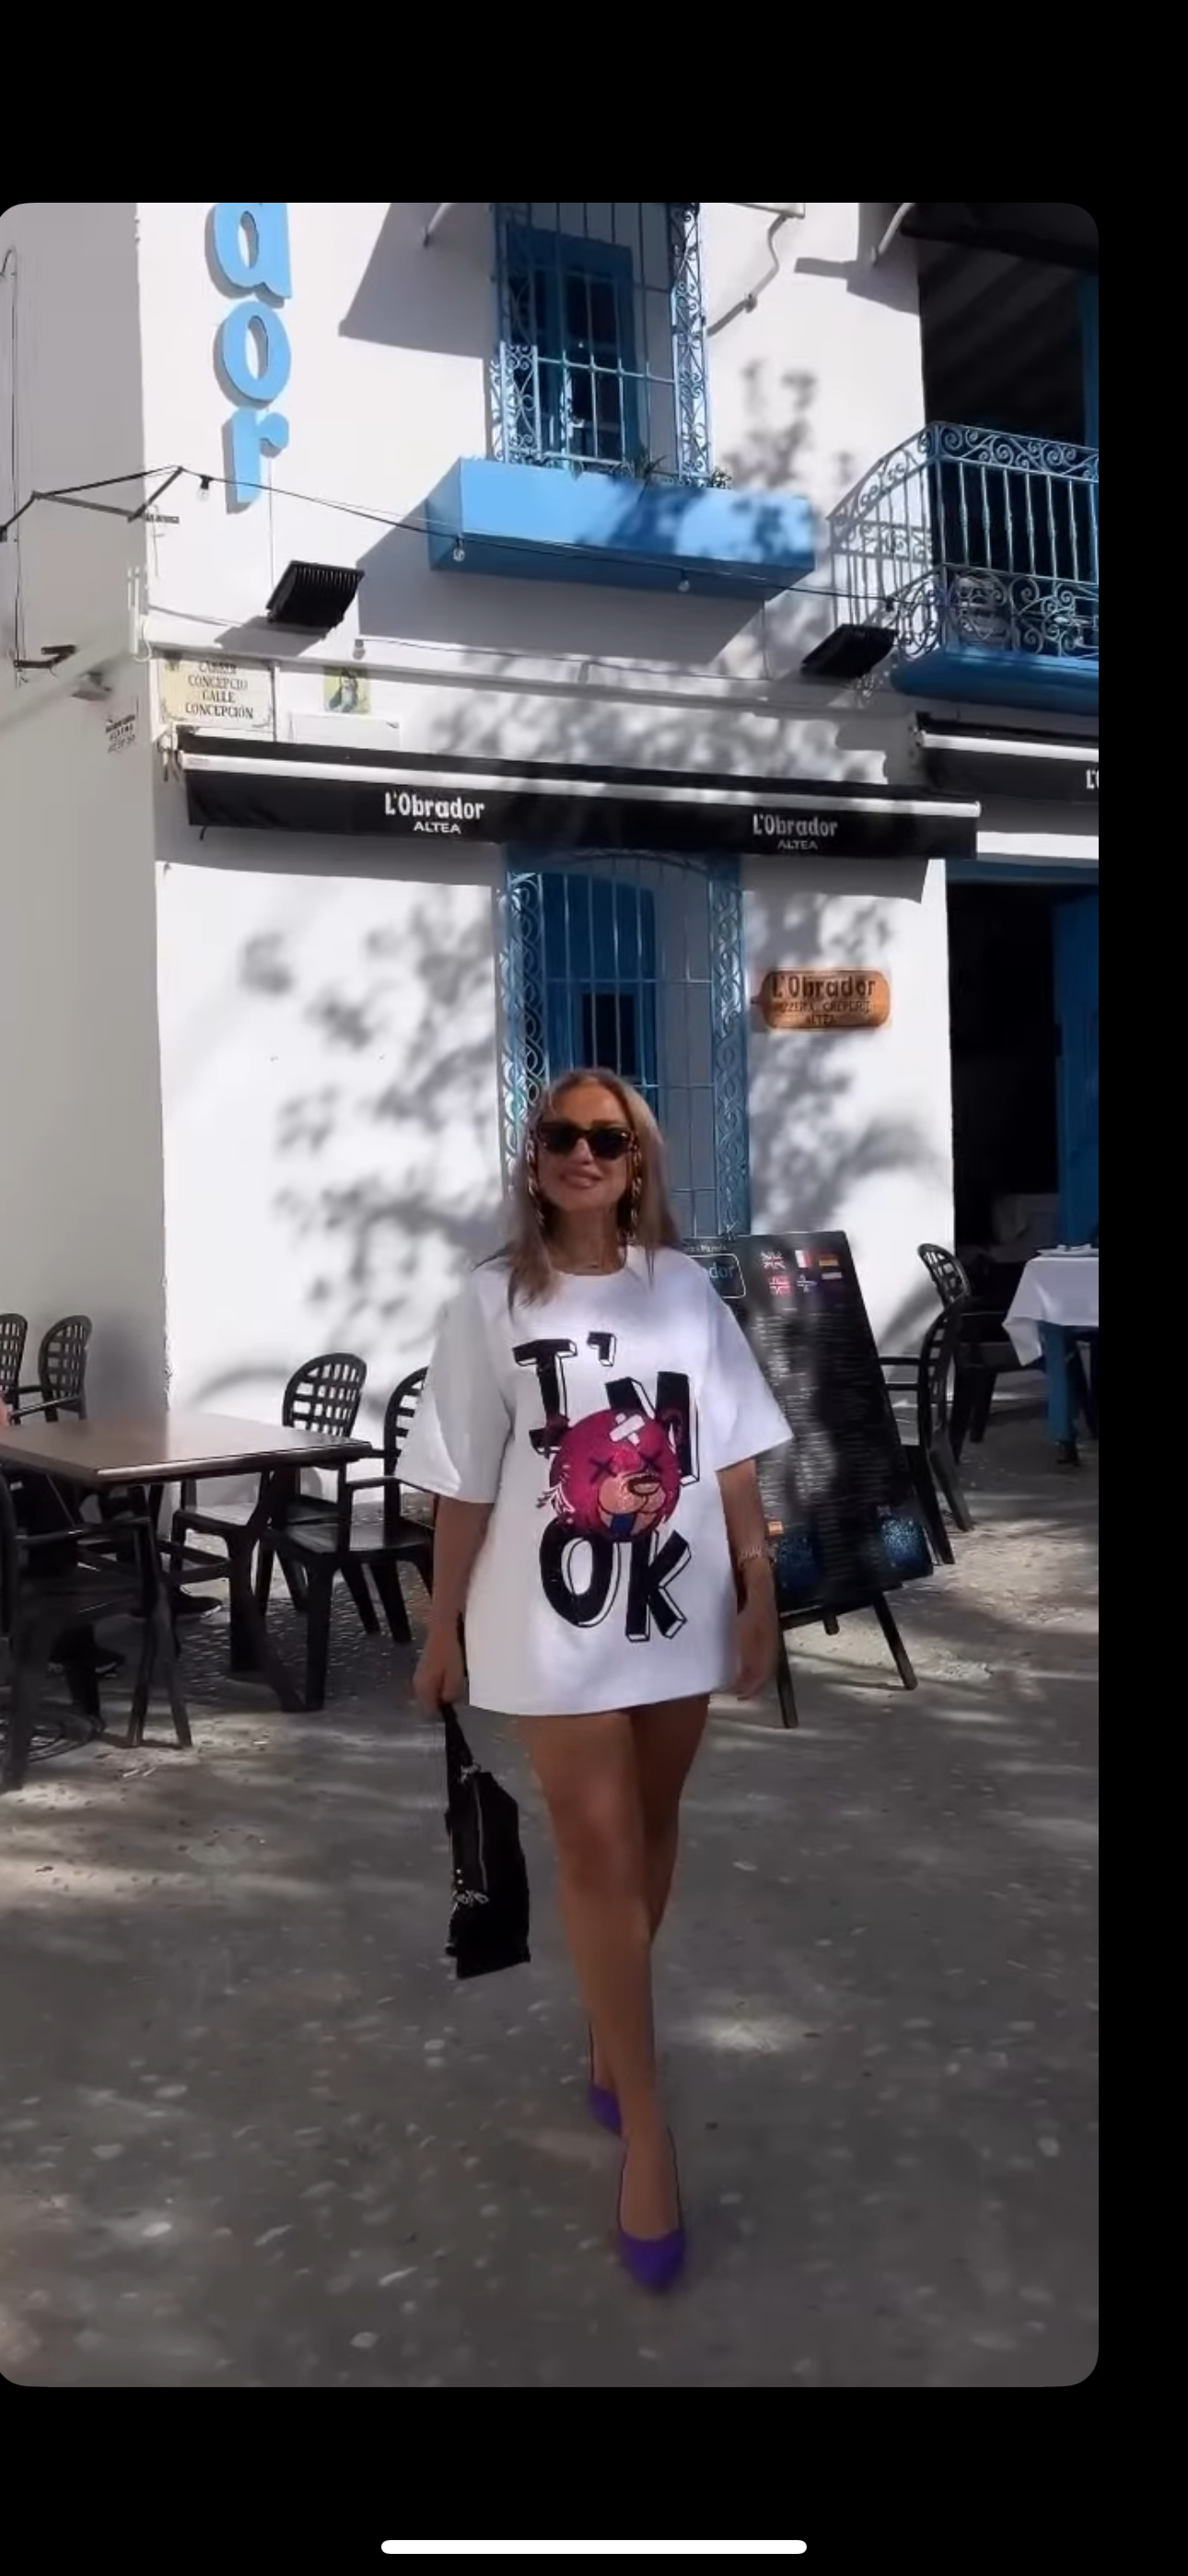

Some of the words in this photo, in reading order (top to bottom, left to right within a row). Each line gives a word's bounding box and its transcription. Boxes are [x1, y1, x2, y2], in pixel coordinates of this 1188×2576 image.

[203, 689, 236, 703] CALLE
[385, 790, 485, 819] L'Obrador
[413, 821, 462, 834] ALTEA
[753, 814, 838, 837] L'Obrador
[777, 839, 818, 849] ALTEA
[772, 975, 876, 998] L'Obrador
[539, 1516, 692, 1642] OK
